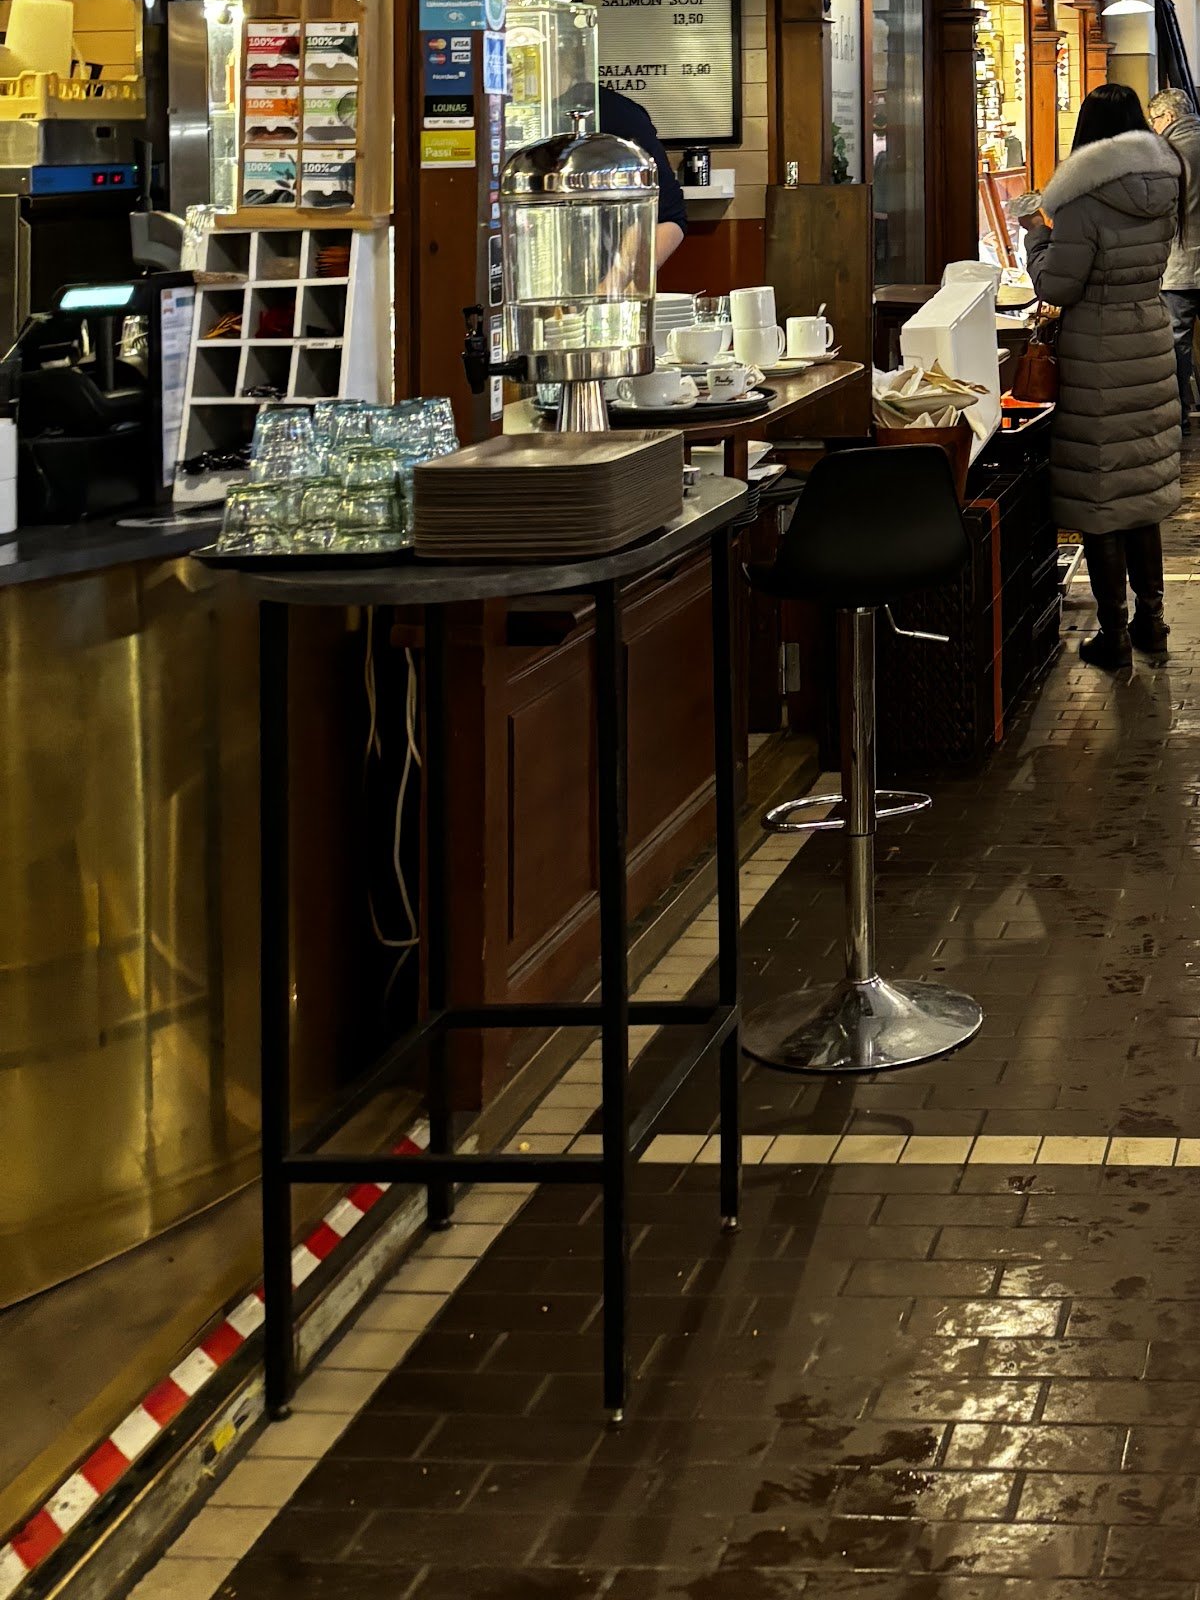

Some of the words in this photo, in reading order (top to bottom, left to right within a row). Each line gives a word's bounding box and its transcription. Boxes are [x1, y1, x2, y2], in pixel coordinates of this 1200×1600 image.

[249, 37, 275, 47] 100%
[307, 37, 332, 47] 100%
[598, 64, 667, 76] SALAATTI
[247, 100, 274, 109] 100%
[304, 100, 331, 109] 100%
[432, 103, 468, 112] LOUNAS
[425, 147, 452, 158] Passi
[246, 162, 272, 172] 100%
[303, 162, 329, 173] 100%
